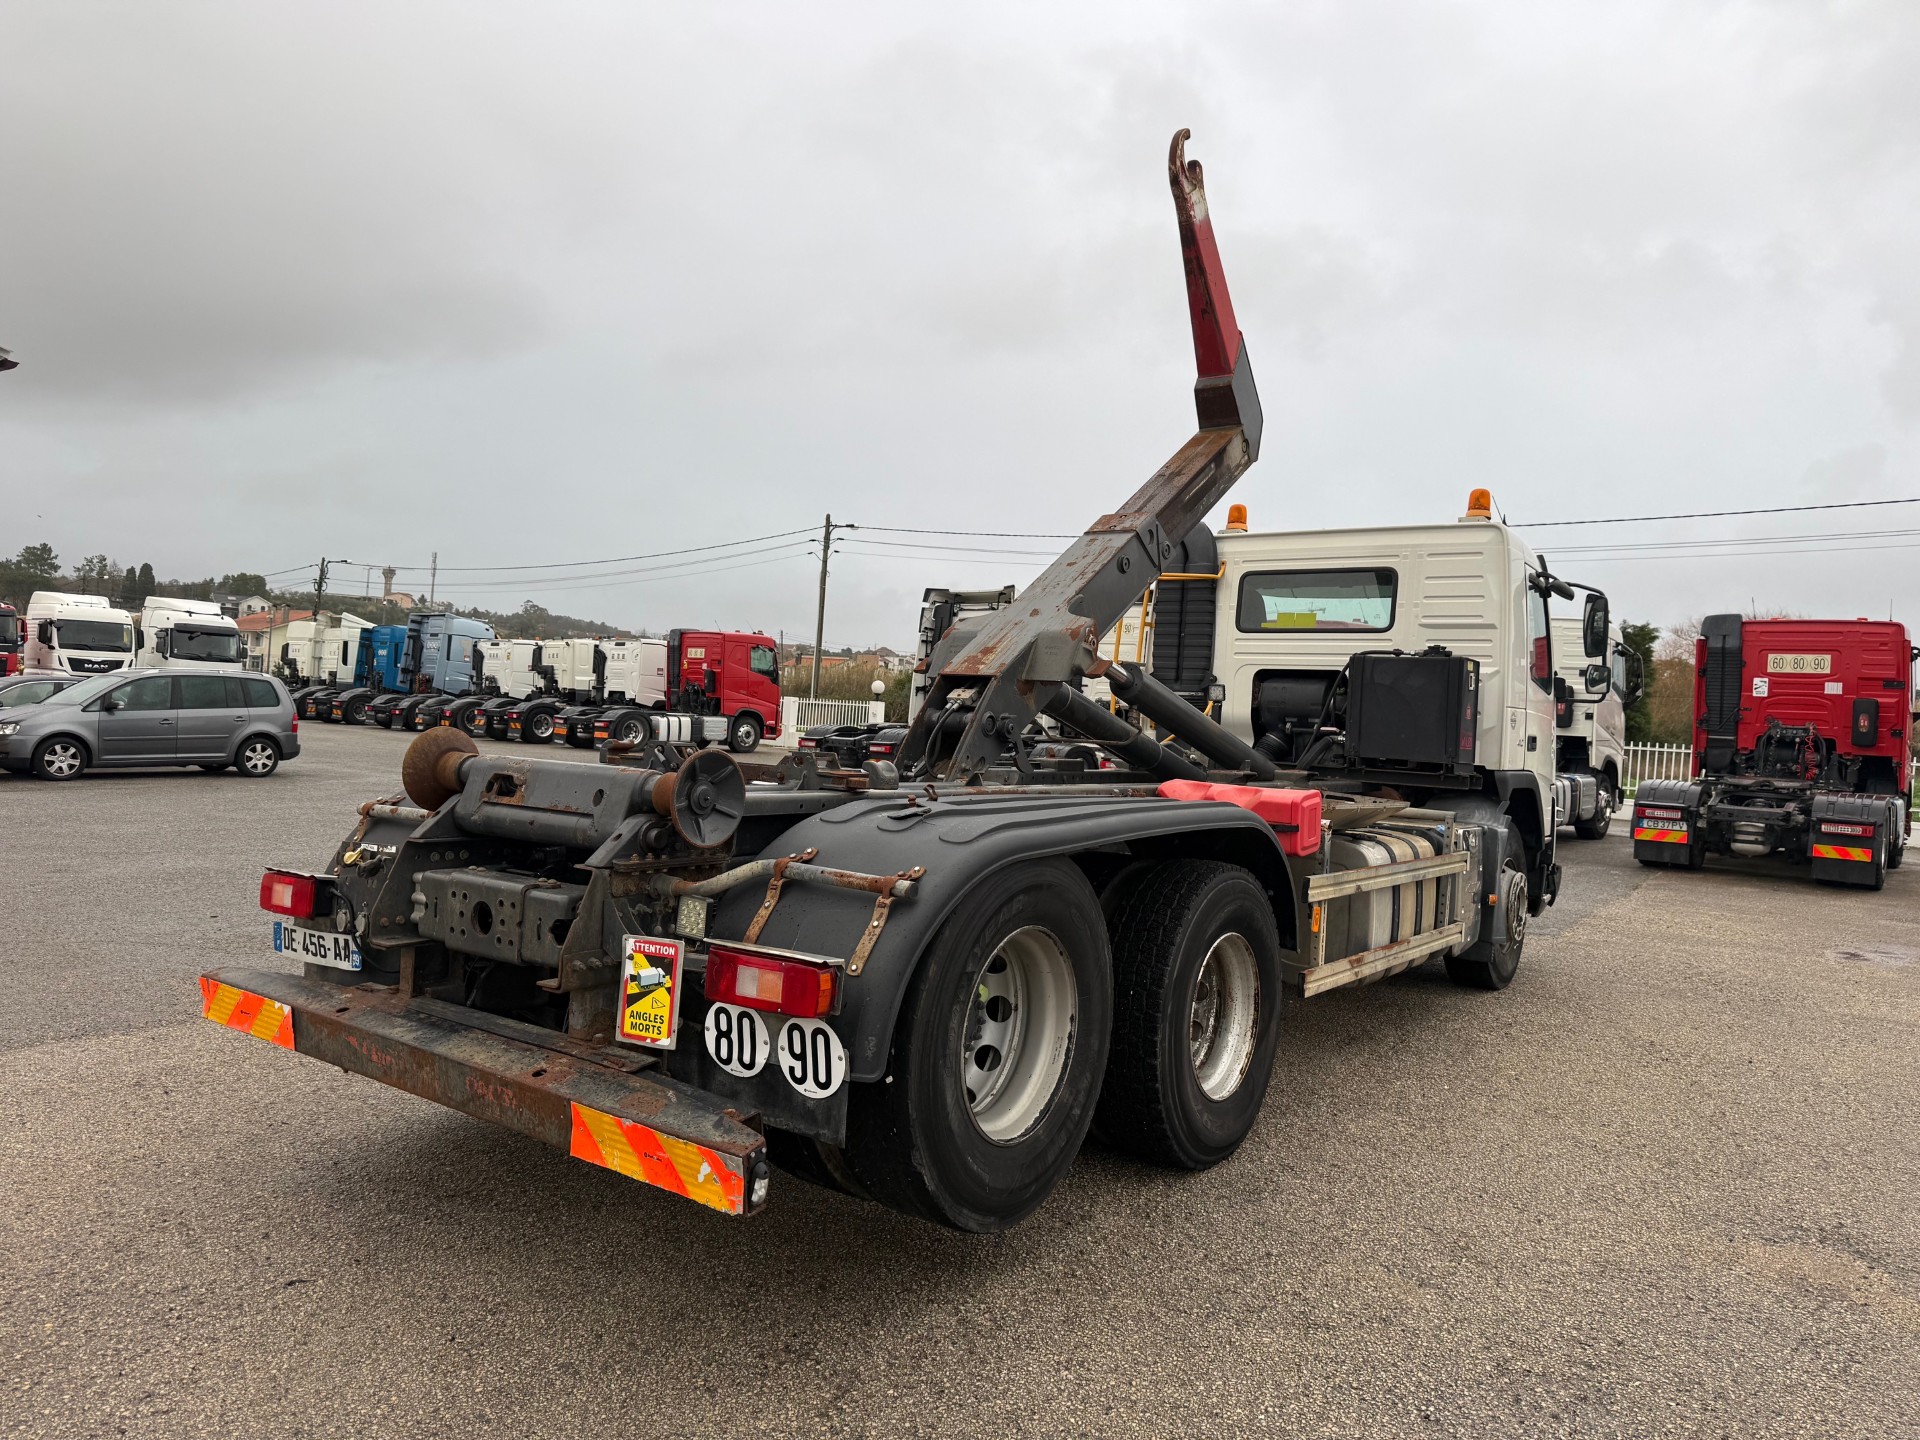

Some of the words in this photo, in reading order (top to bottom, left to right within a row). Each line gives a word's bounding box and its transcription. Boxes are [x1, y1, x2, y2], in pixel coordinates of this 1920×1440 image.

[1772, 657, 1784, 669] 60
[1792, 657, 1805, 670] 80
[1813, 658, 1826, 670] 90
[629, 1010, 665, 1025] ANGLES
[630, 1021, 662, 1035] MORTS
[714, 1006, 756, 1071] 80
[787, 1022, 832, 1091] 90
